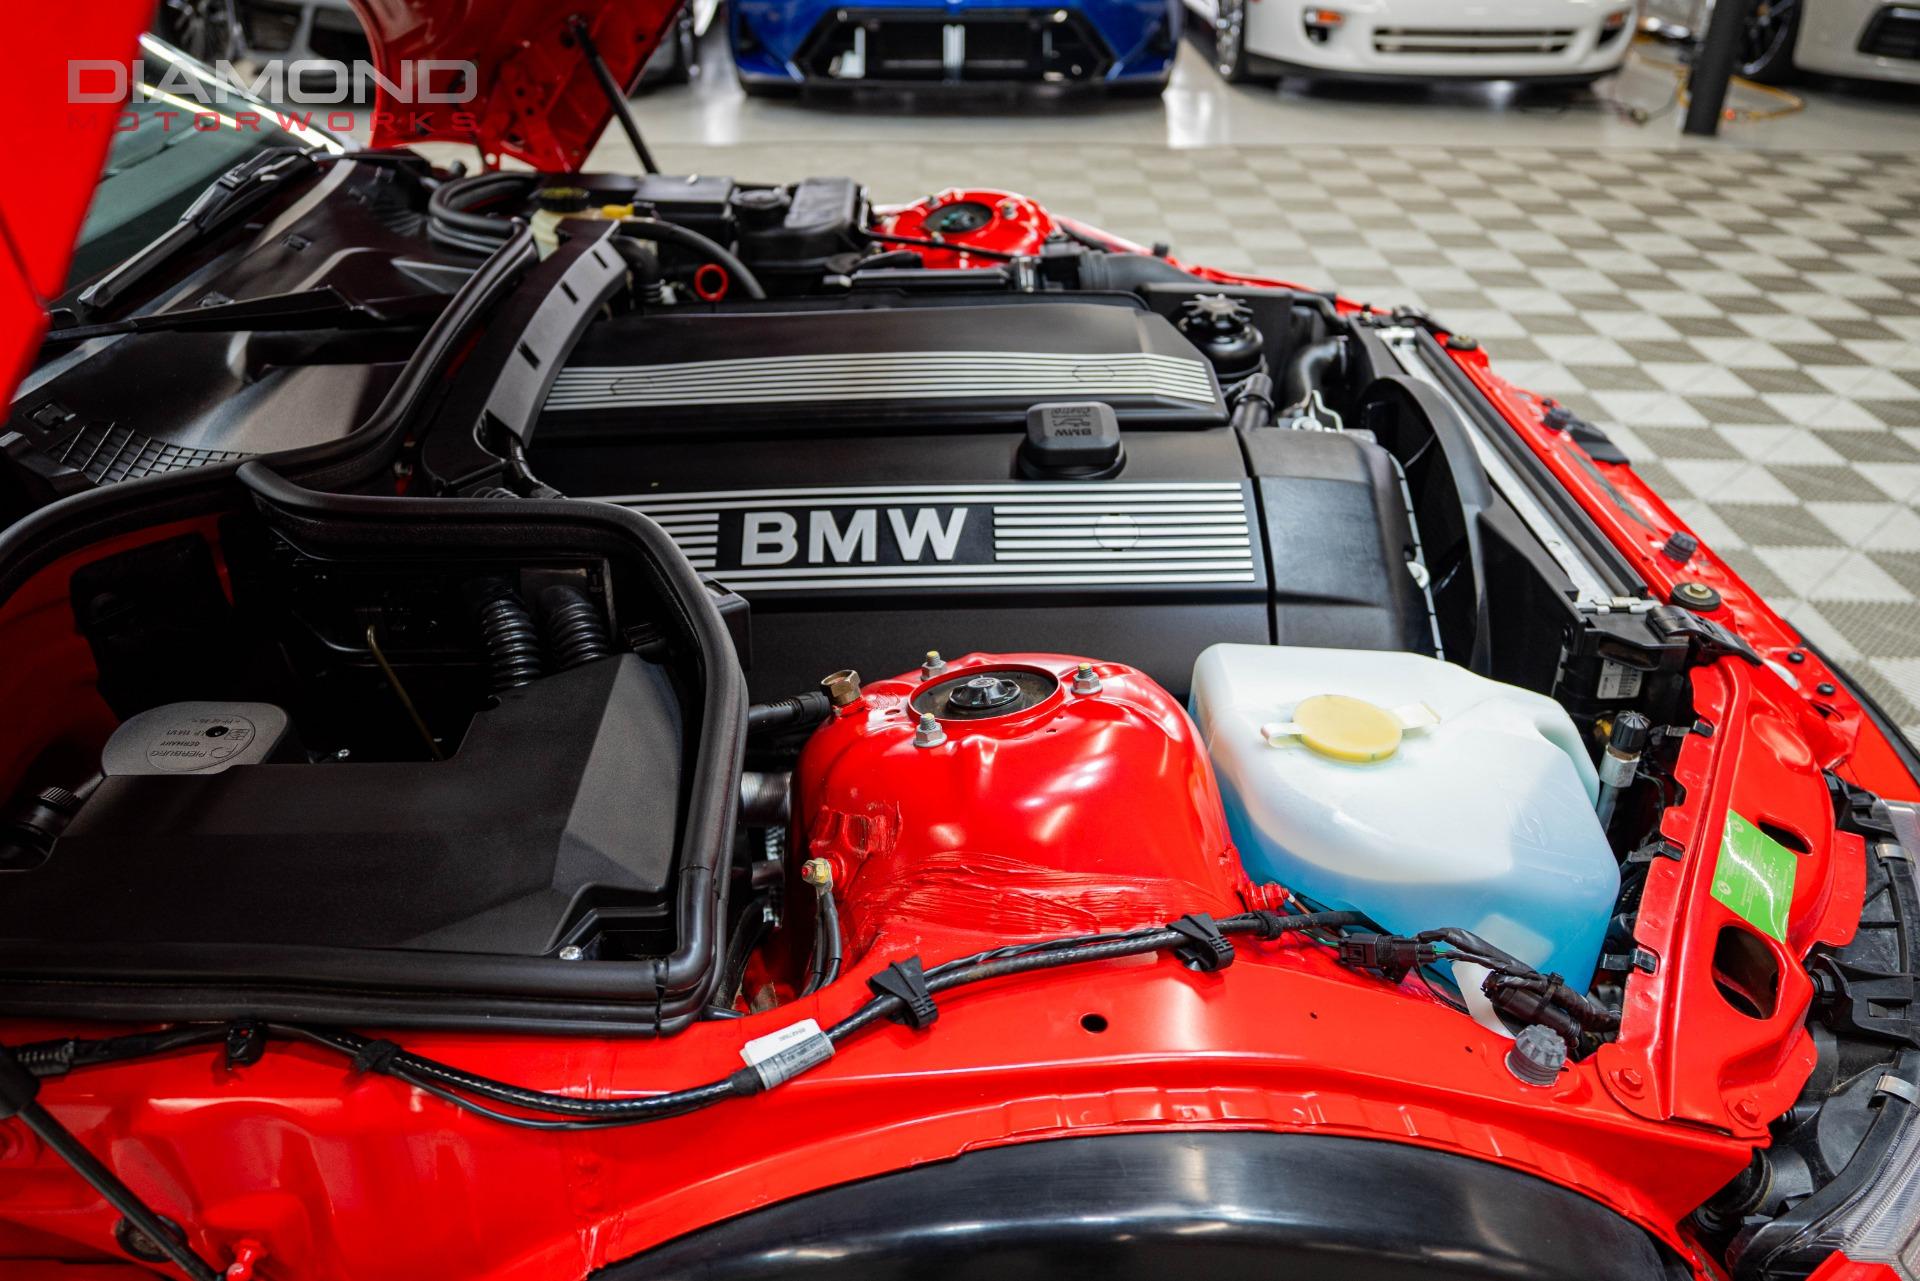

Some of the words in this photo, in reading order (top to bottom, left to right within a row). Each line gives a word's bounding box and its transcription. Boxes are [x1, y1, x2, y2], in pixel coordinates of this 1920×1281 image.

[1054, 428, 1092, 437] BMW
[741, 507, 968, 566] BMW
[151, 750, 207, 758] PIERBURG
